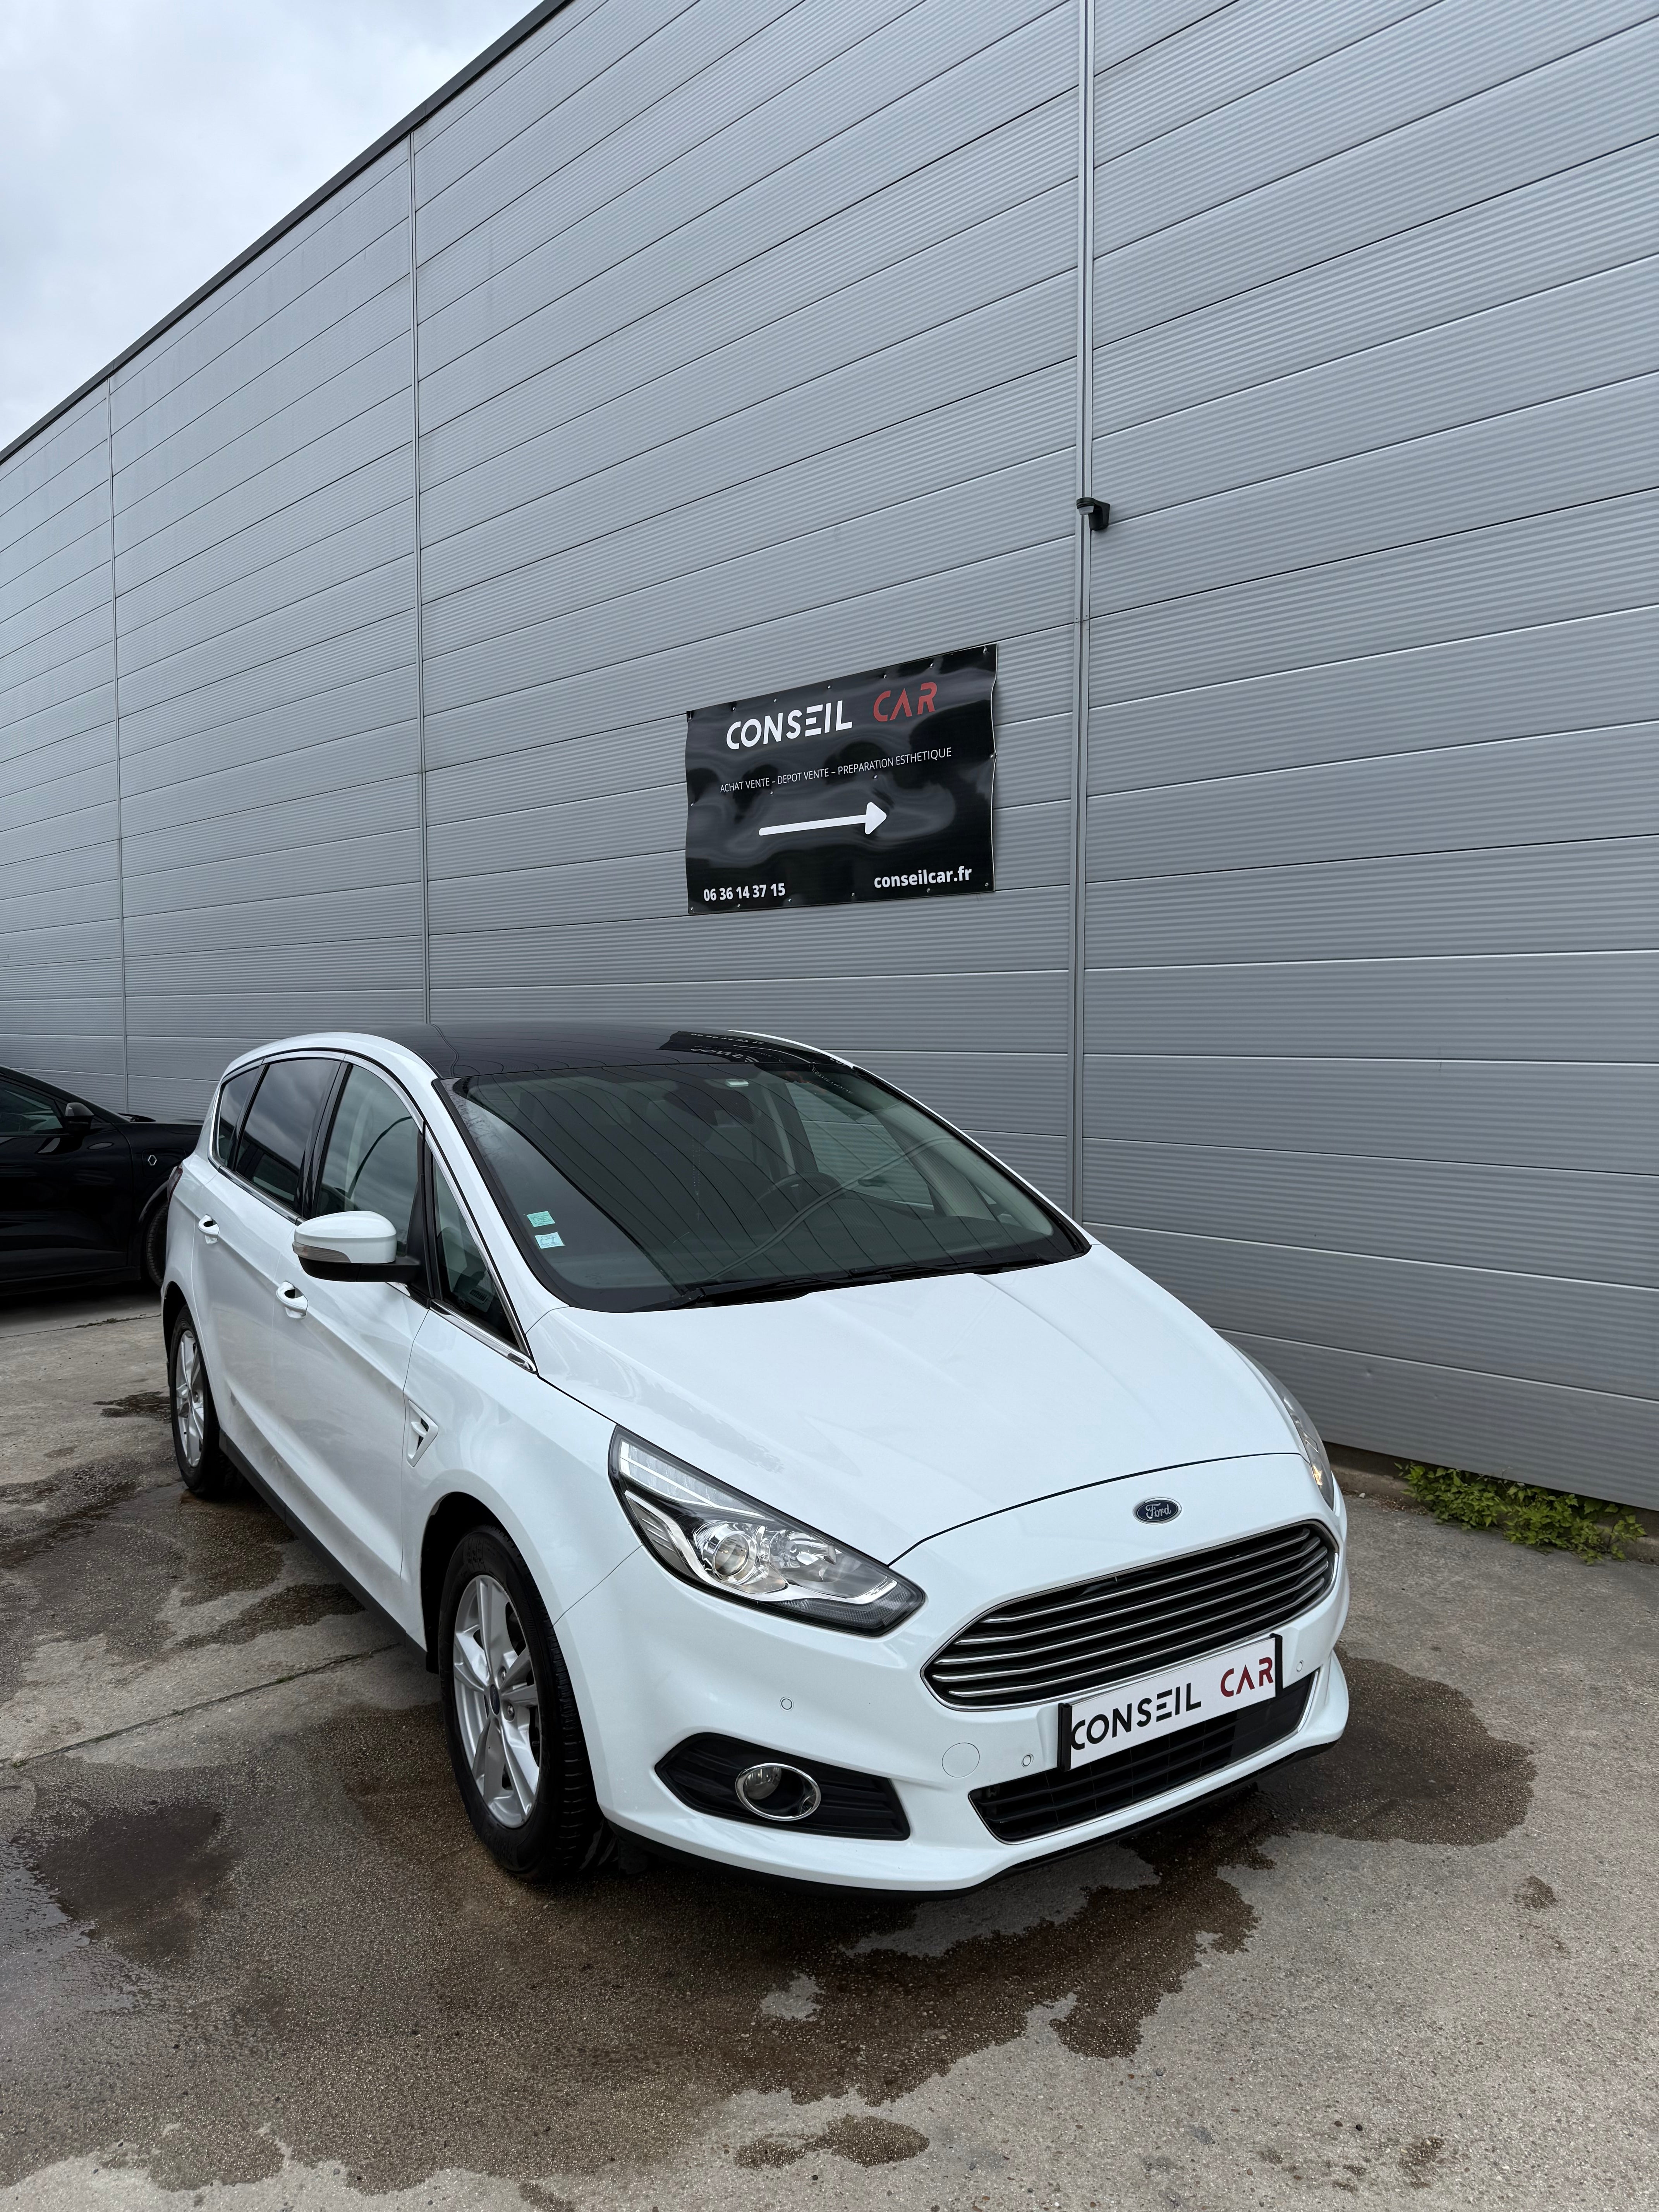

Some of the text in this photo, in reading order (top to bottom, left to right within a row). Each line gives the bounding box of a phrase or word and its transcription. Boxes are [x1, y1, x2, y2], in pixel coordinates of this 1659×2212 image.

[726, 682, 938, 750] CONSEIL CAR
[720, 781, 744, 793] ACHAT
[745, 777, 770, 789] VENTE
[777, 772, 802, 785] DEPOT
[803, 768, 829, 780] VENTE
[838, 757, 893, 775] PREPARATION
[896, 747, 952, 766] ESTHETIQUE
[704, 883, 785, 902] 06 36 14 37 15
[874, 866, 972, 888] conseilcar.fr
[1145, 1503, 1171, 1519] Ford
[1071, 1657, 1274, 1750] CONSEIL CAR
